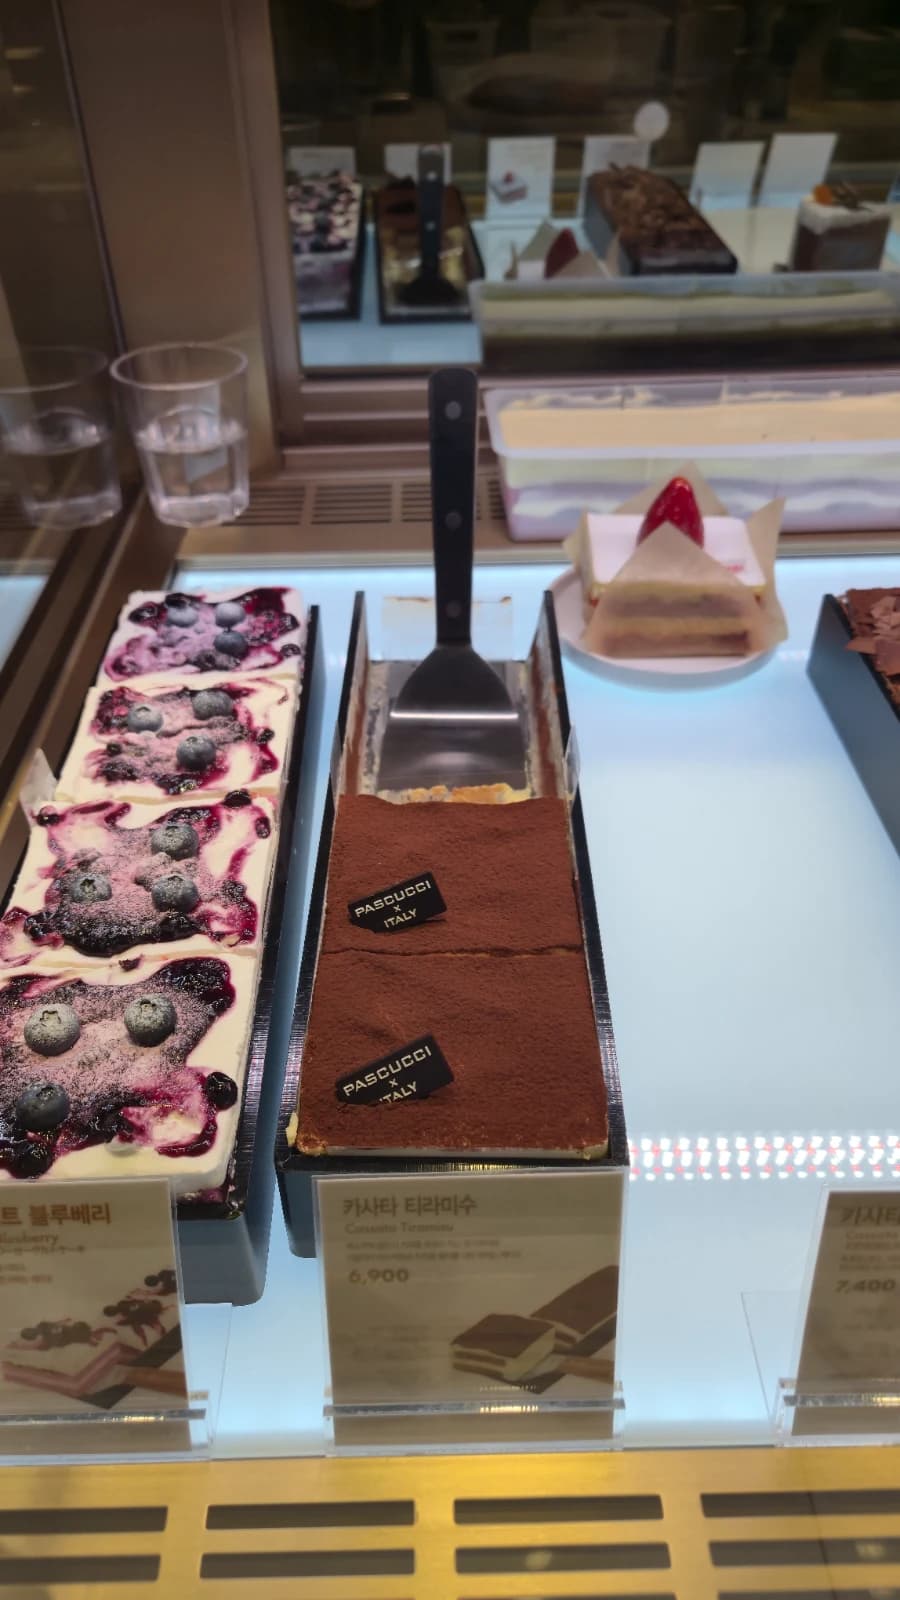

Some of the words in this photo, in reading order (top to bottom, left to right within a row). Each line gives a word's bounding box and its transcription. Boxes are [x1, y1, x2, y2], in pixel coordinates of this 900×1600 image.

[354, 880, 432, 918] PASCUCCI
[383, 908, 417, 928] ITALY
[342, 1045, 432, 1097] PASCUCCI
[29, 1202, 111, 1226] 블루베리
[343, 1194, 398, 1217] 카사타
[404, 1193, 477, 1217] 티라미수
[348, 1267, 410, 1286] 6,900
